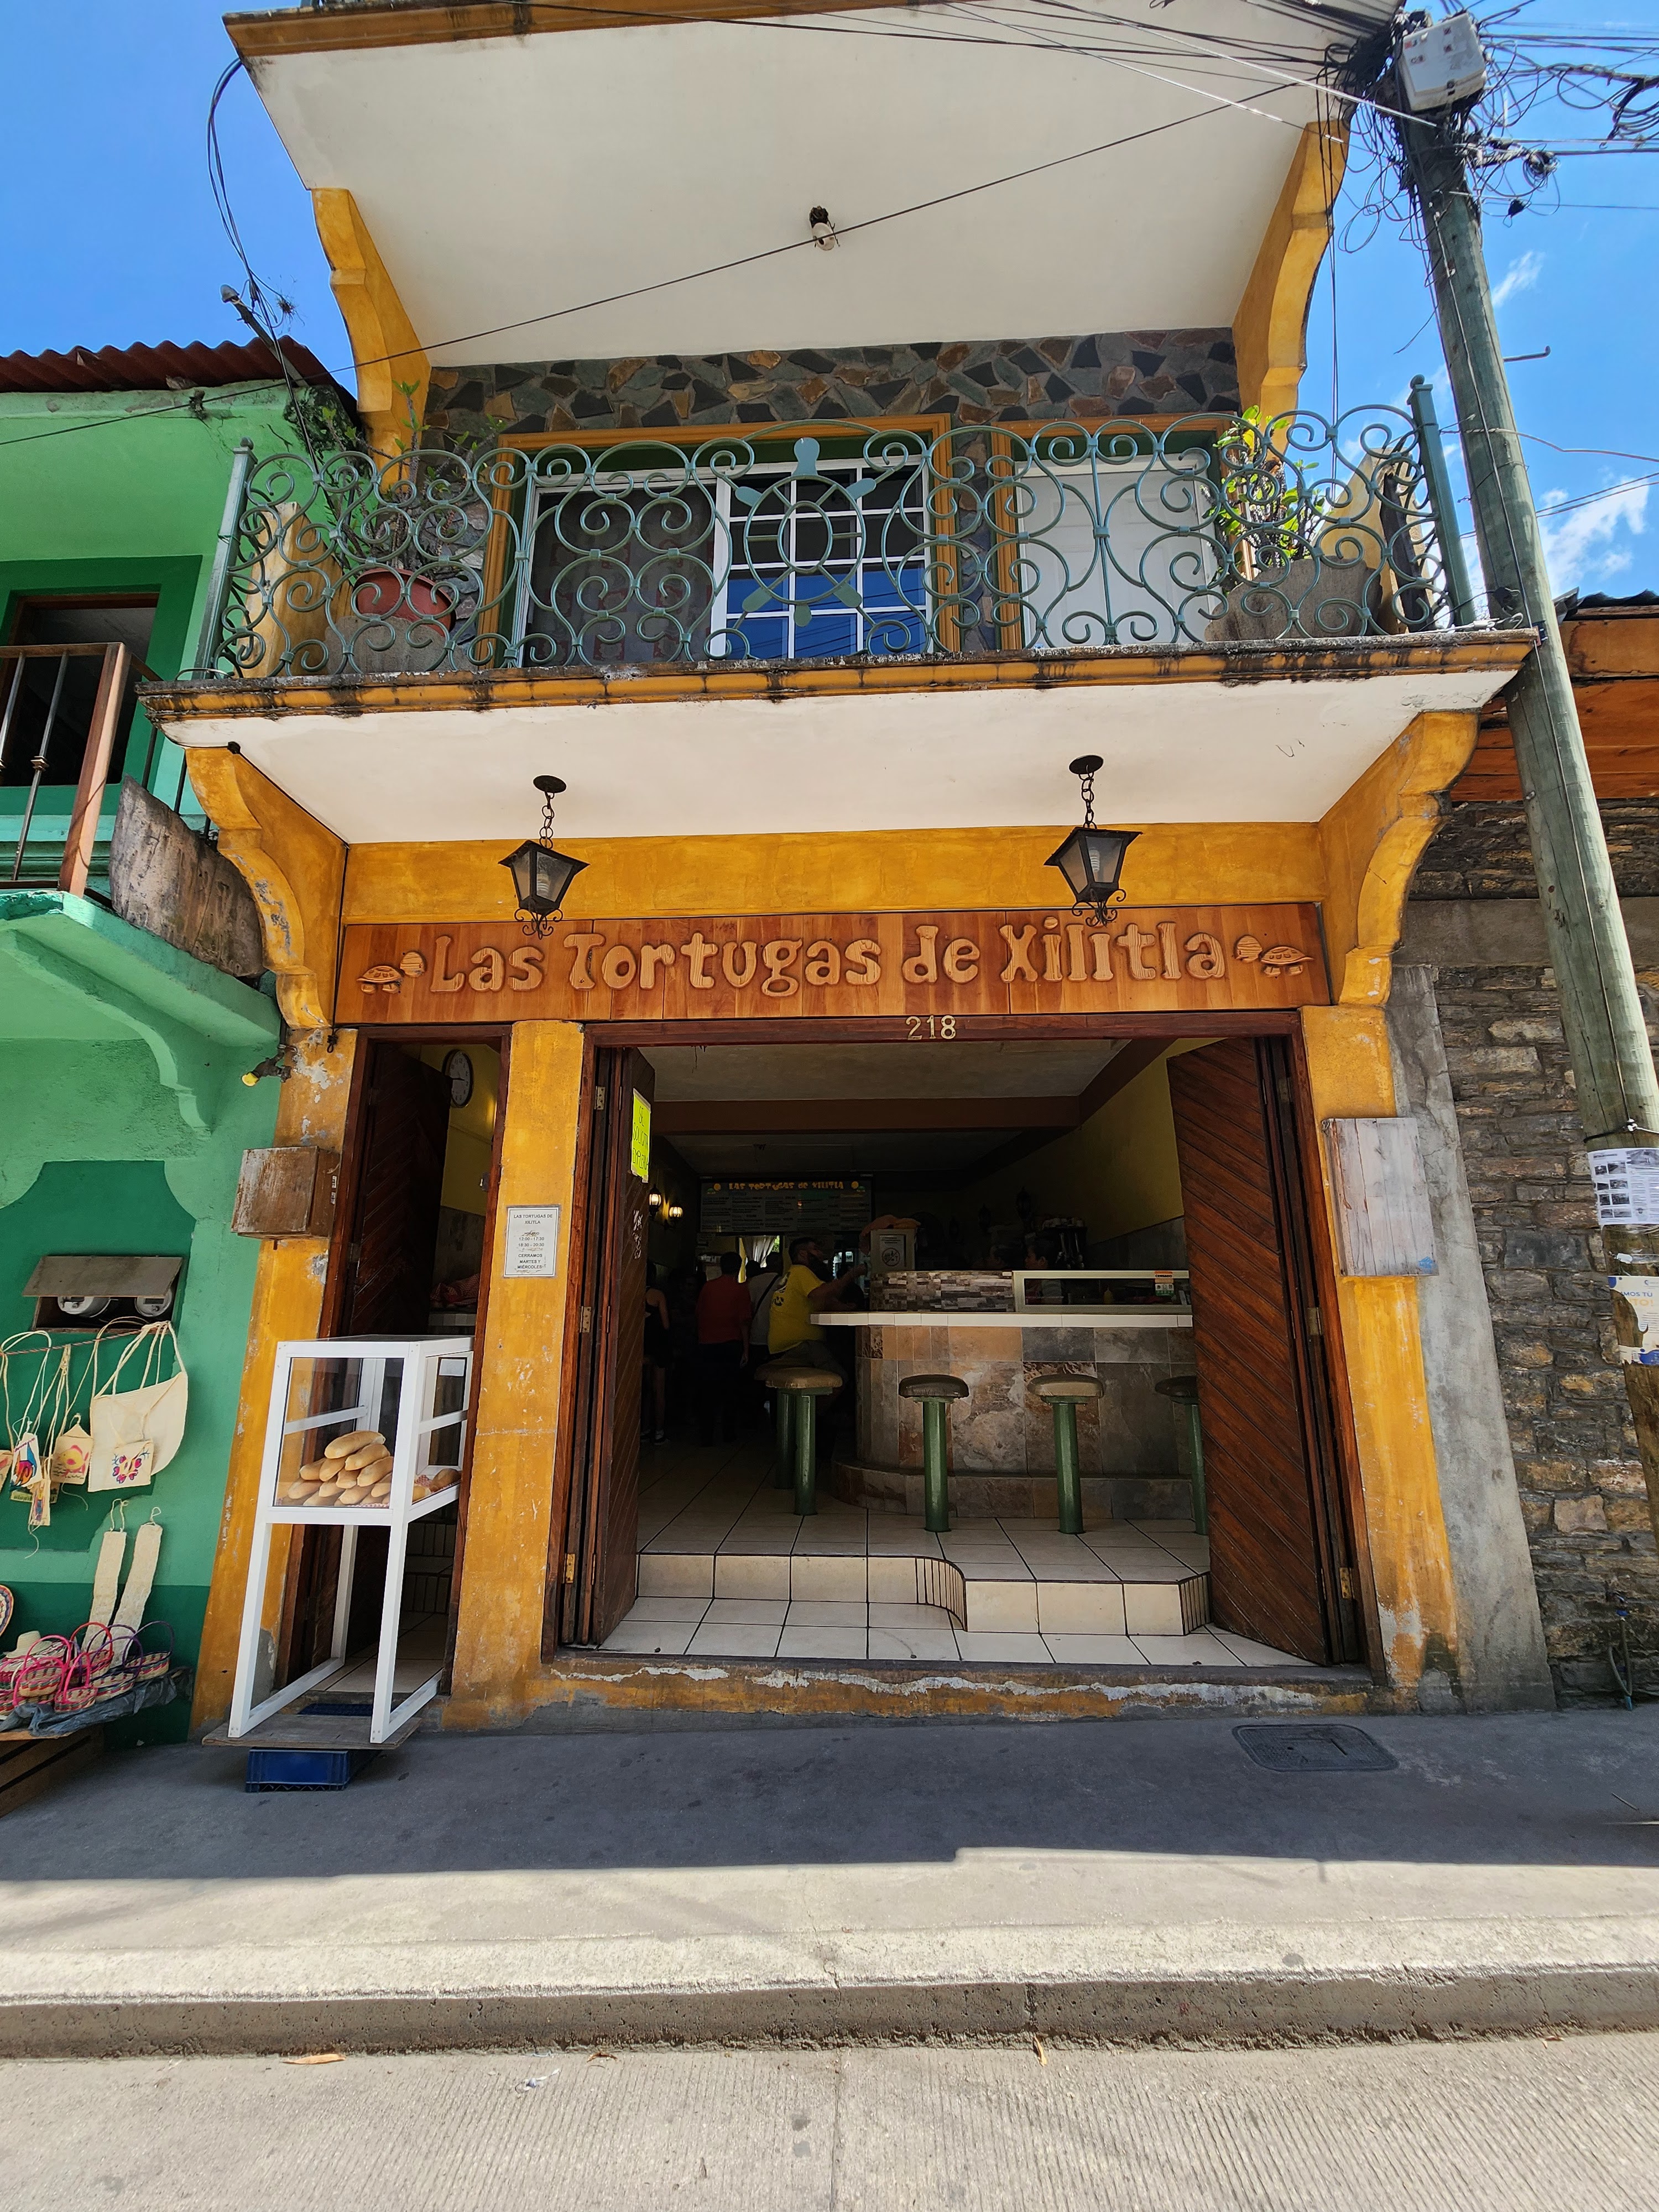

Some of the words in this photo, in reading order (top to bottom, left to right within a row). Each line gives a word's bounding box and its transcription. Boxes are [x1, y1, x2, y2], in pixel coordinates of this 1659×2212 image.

[429, 935, 545, 993] Las
[563, 932, 882, 997] Tortugas
[901, 925, 981, 984] de
[999, 916, 1226, 982] Xilitla
[906, 1015, 956, 1040] 218
[639, 1105, 644, 1127] SE
